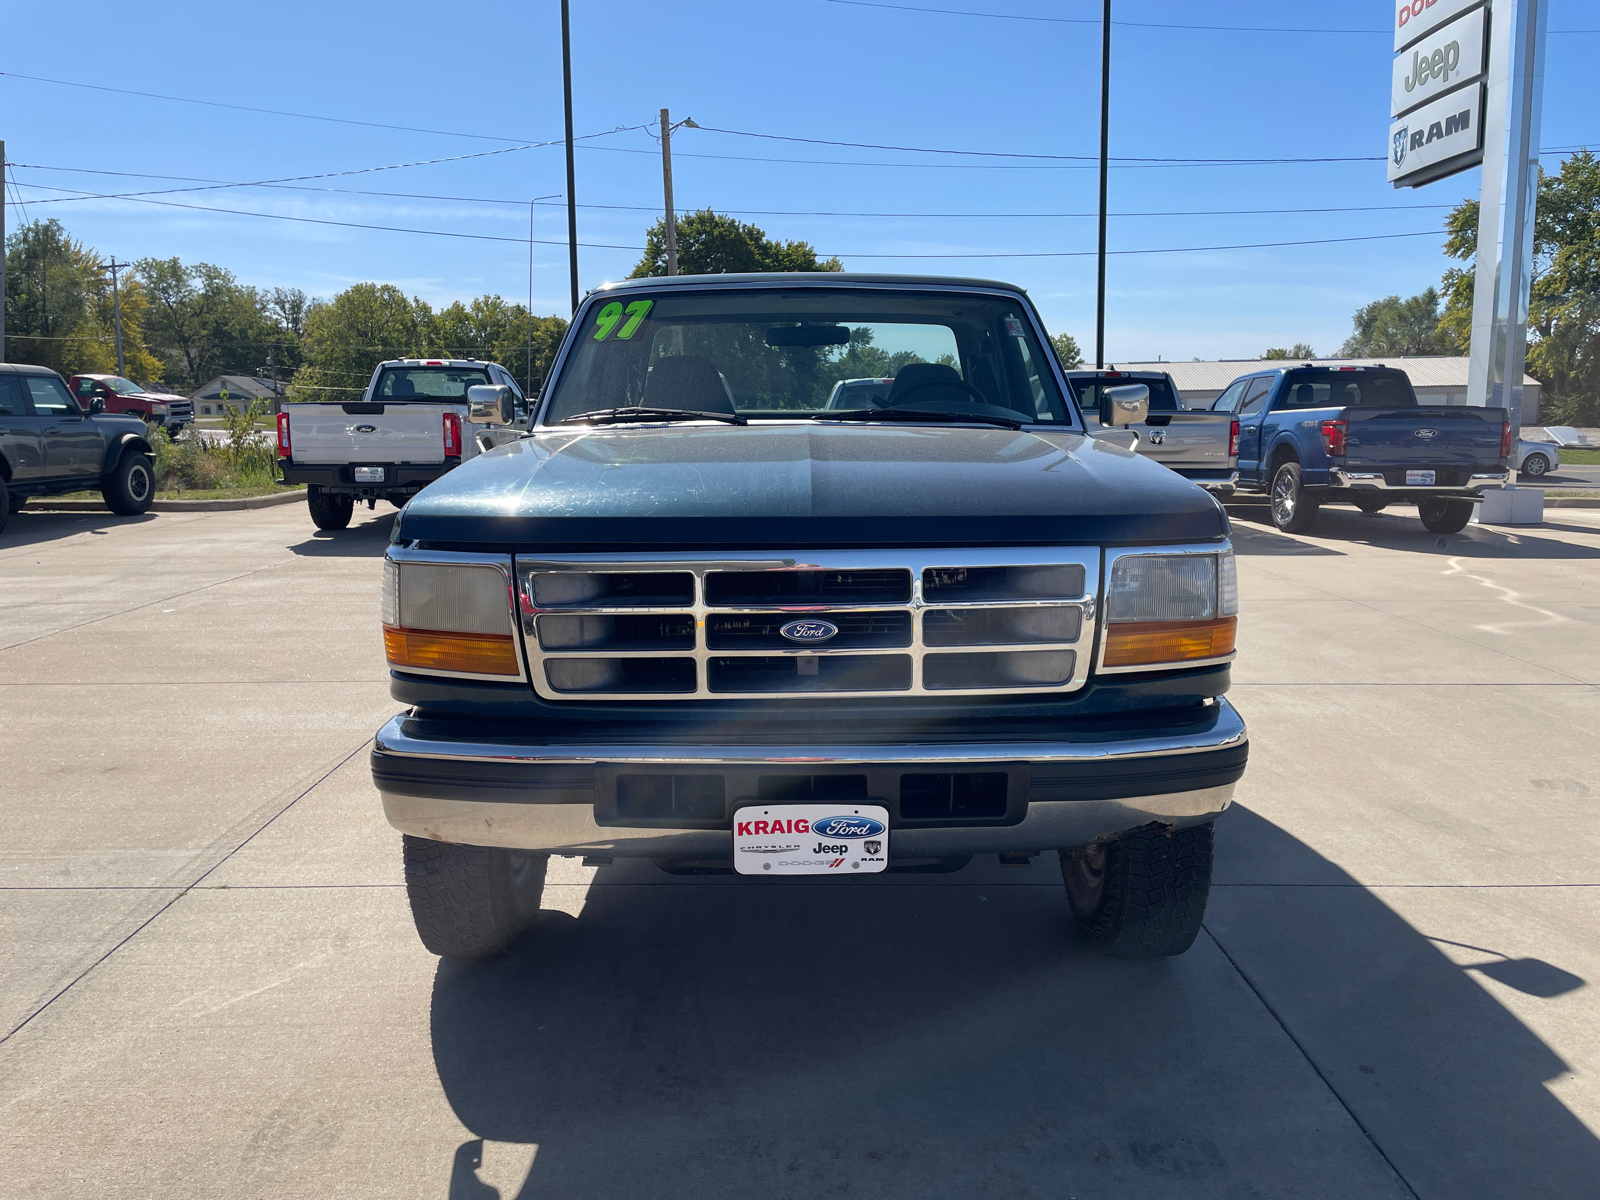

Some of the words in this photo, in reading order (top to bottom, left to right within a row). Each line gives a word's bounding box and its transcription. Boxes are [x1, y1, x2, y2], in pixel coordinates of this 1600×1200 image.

[1404, 40, 1460, 92] Jeep
[1410, 109, 1471, 151] RAM
[593, 300, 654, 341] 97
[794, 624, 825, 637] Ford
[737, 819, 810, 836] KRAIG
[826, 819, 870, 835] Ford
[813, 842, 848, 855] Jeep
